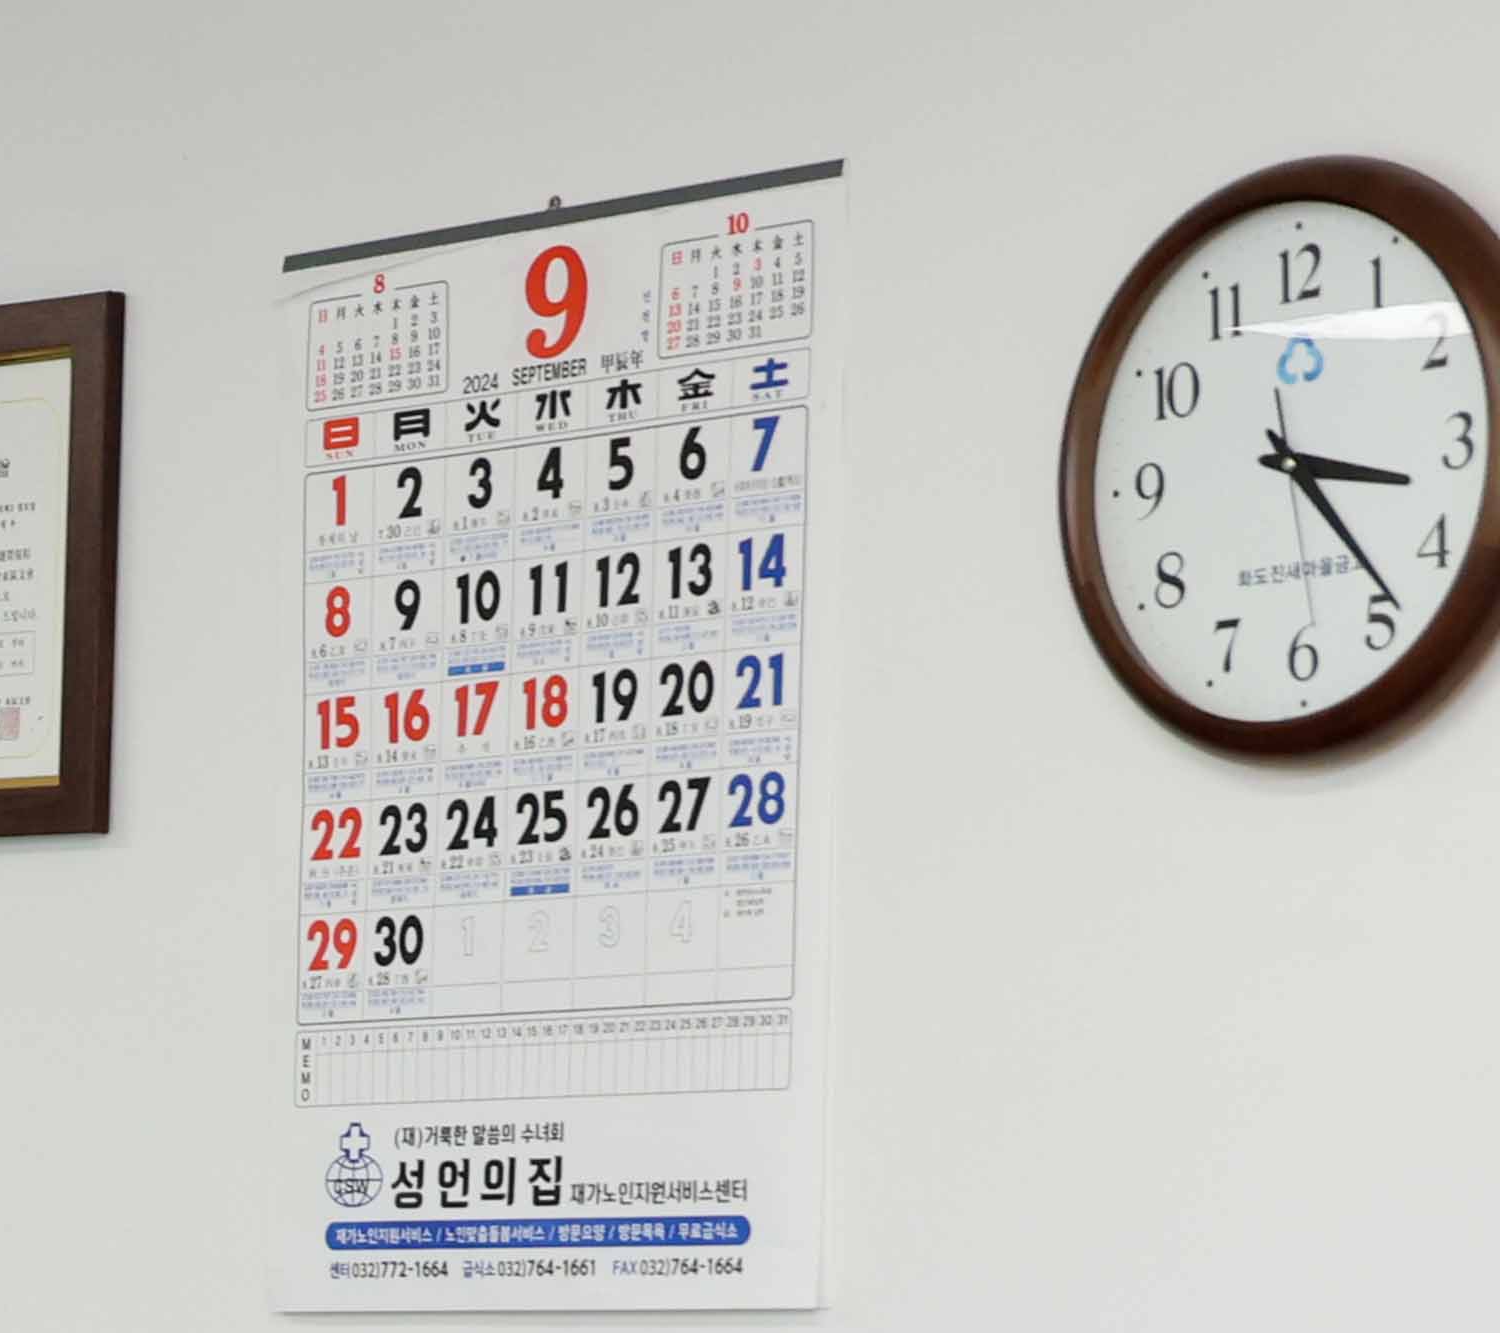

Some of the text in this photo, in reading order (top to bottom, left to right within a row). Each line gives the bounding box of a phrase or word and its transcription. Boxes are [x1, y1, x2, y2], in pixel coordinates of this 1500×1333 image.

[726, 212, 749, 234] 10
[373, 274, 386, 294] 8
[1279, 242, 1322, 304] 12
[1370, 256, 1382, 308] 1
[525, 245, 588, 359] 9
[1207, 283, 1242, 341] 11
[1422, 309, 1449, 371] 2
[323, 358, 788, 450] 日 月 火 水 木 金 土
[462, 373, 500, 393] 2024
[511, 358, 588, 386] SEPTEMBER
[1154, 362, 1200, 420] 10
[394, 440, 427, 452] MON
[467, 430, 496, 443] TUE
[535, 420, 568, 432] WED
[607, 410, 638, 423] THU
[1441, 411, 1474, 470] 3
[332, 416, 780, 526] 1 2 3 4 5 6 7
[1135, 462, 1165, 520] 9
[1416, 514, 1450, 569] 4
[325, 534, 786, 637] 8 9 10 11 12 13 14
[1155, 552, 1186, 608] 8
[1214, 618, 1241, 673] 7
[1364, 593, 1398, 650] 5
[1288, 624, 1319, 681] 6
[317, 653, 783, 750] 15 16 17 18 19 20 21
[311, 771, 785, 861] 22 23 24 25 26 27 28
[307, 915, 423, 971] 29 30
[394, 1122, 565, 1150] (재)거룩한 말씀의 수녀회
[570, 1178, 748, 1206] 재가노인지원서비스센터
